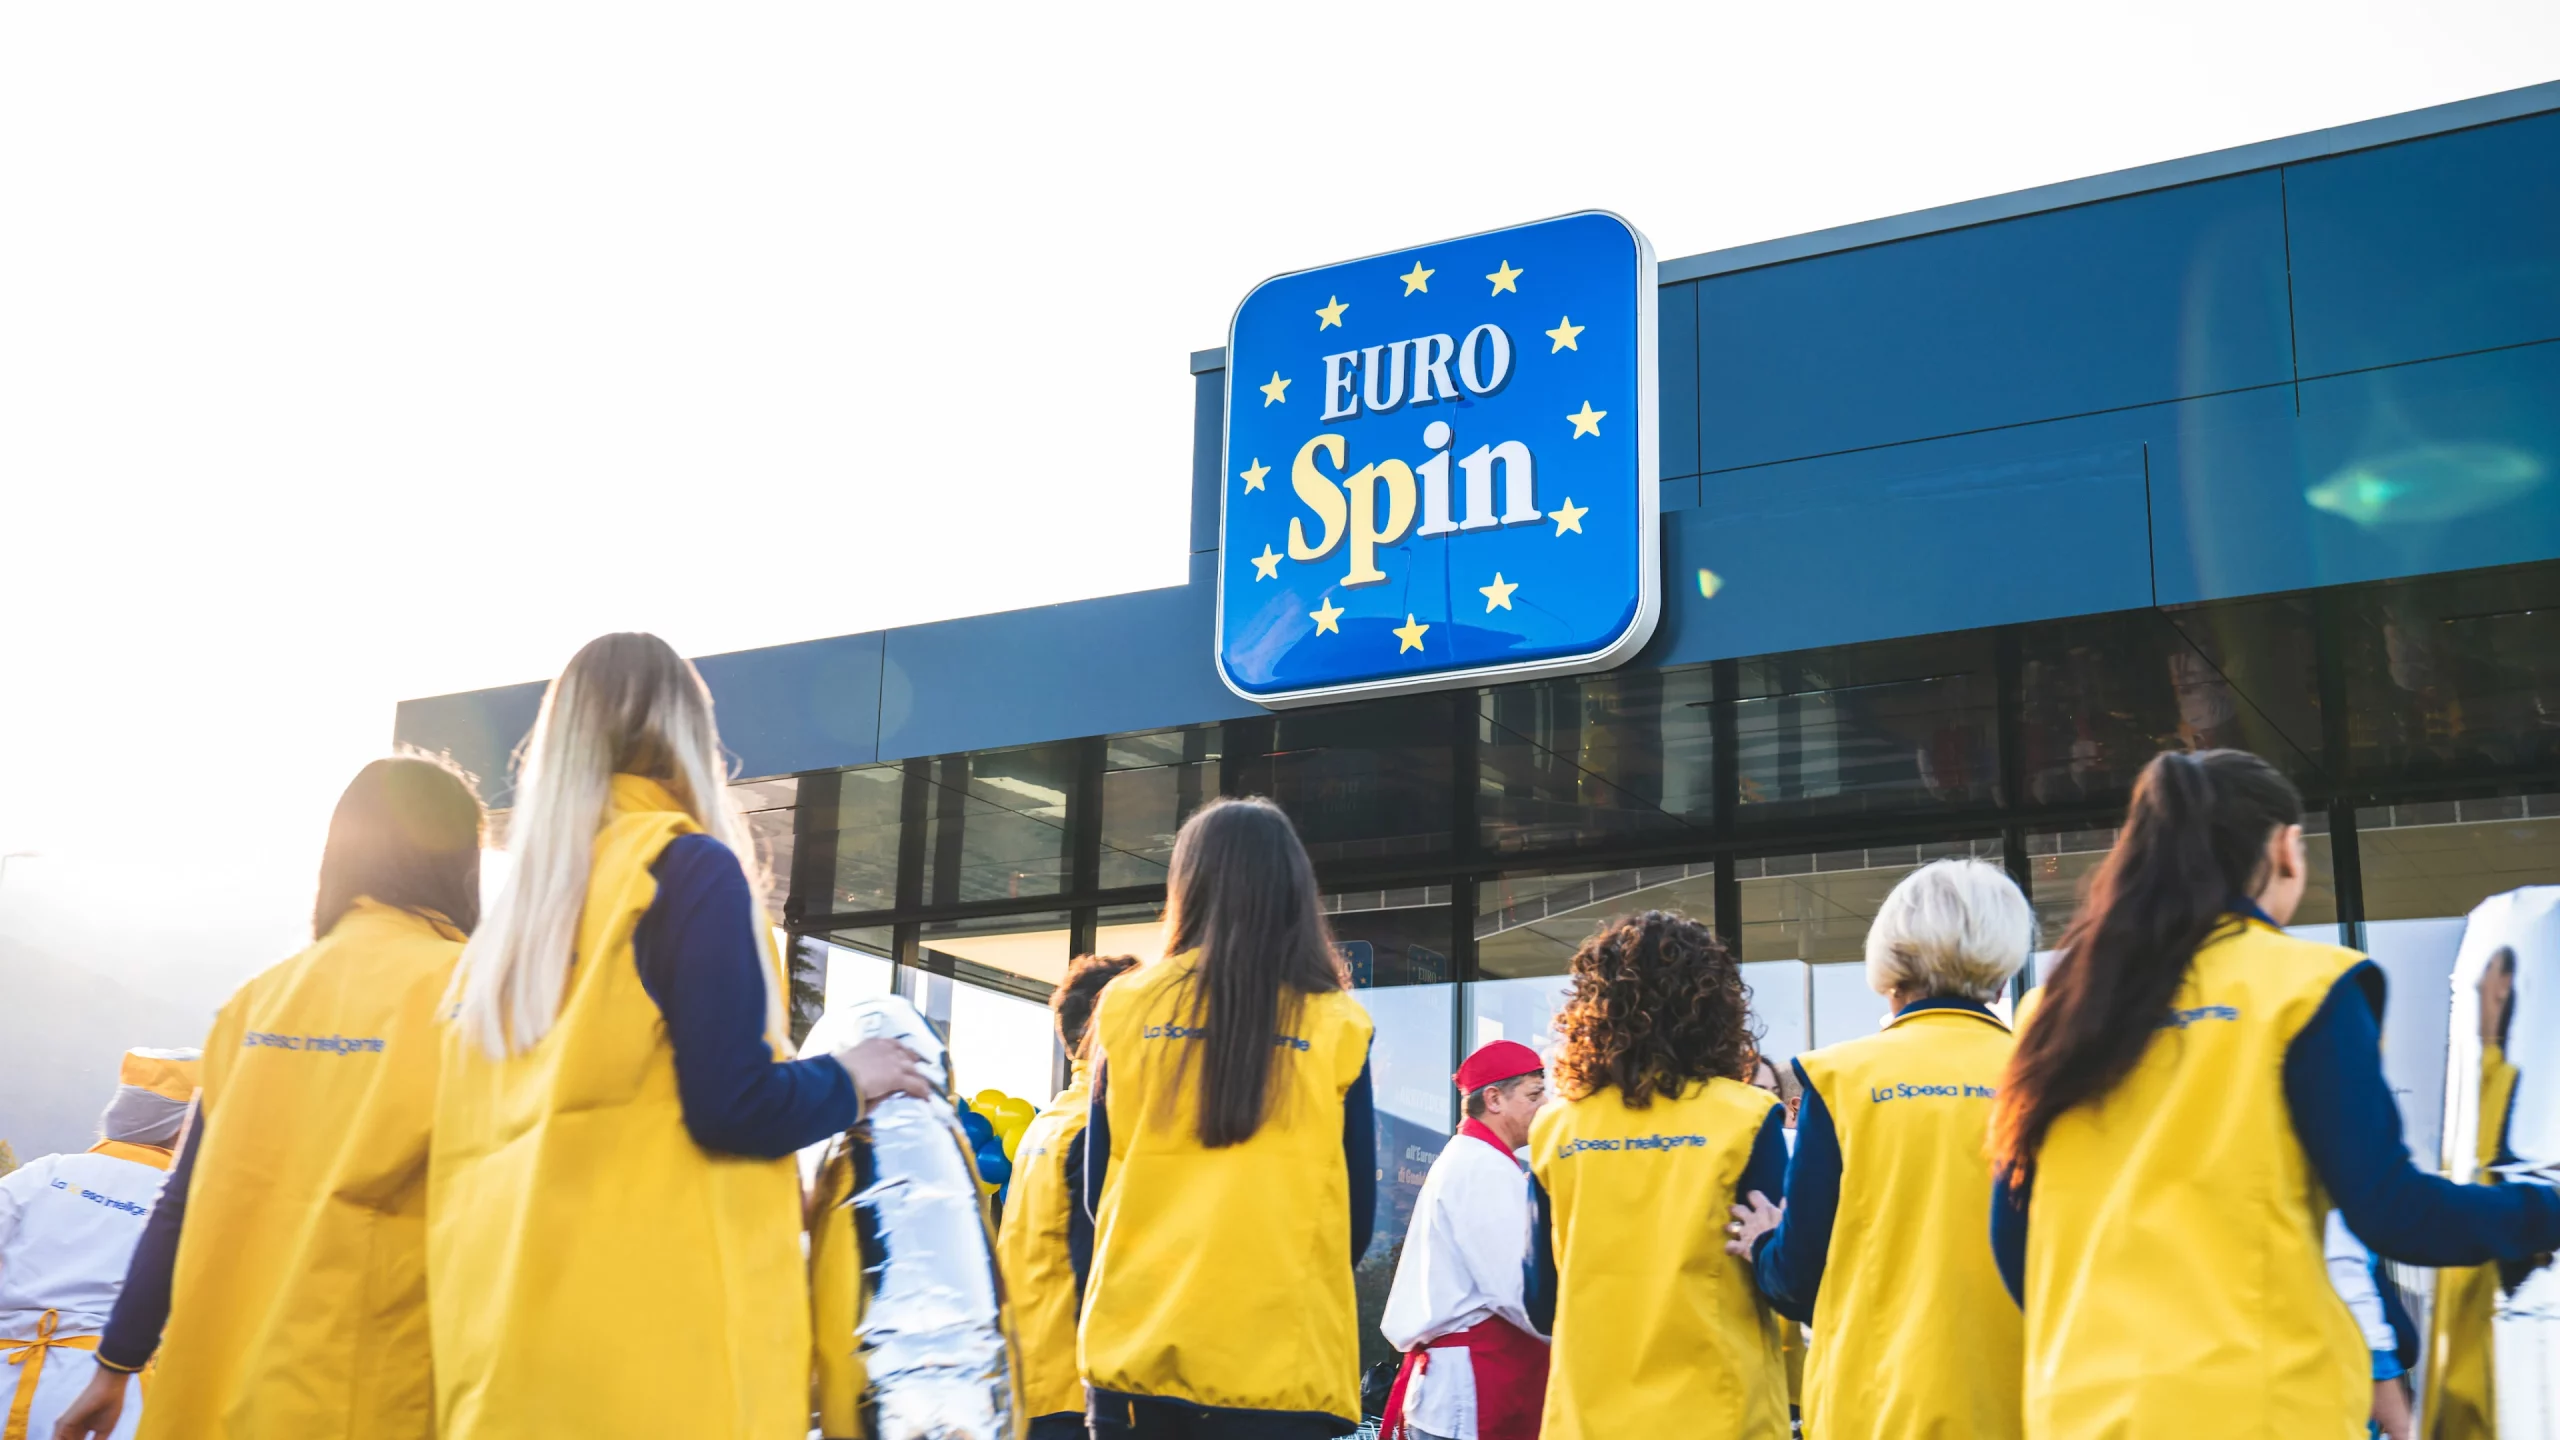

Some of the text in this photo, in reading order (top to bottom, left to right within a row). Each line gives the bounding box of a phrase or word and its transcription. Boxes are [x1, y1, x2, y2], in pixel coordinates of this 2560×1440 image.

[1320, 322, 1513, 424] EURO
[1287, 420, 1544, 588] Spin
[1143, 1025, 1161, 1039] La
[1871, 1086, 1894, 1103] La
[1896, 1082, 1958, 1099] Spesa
